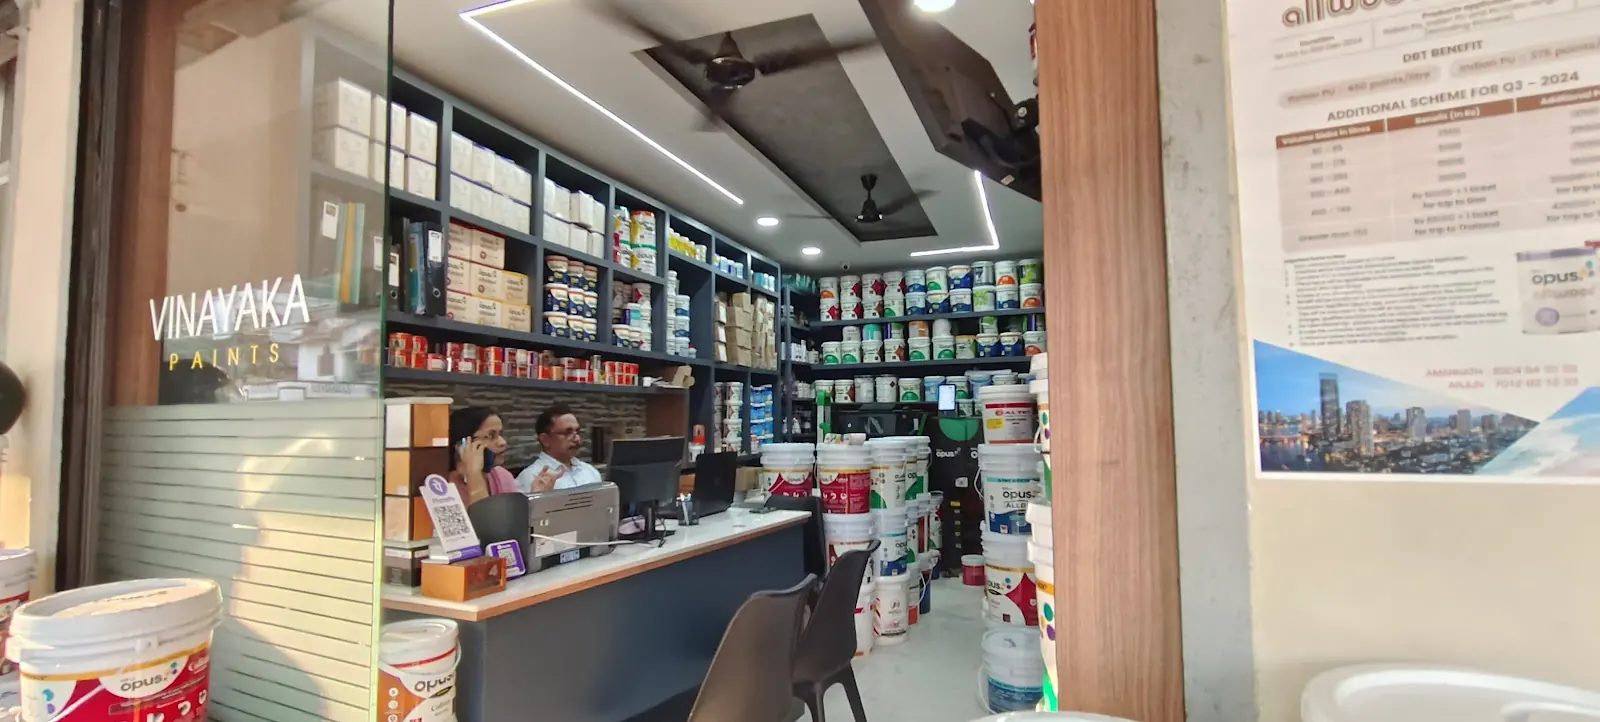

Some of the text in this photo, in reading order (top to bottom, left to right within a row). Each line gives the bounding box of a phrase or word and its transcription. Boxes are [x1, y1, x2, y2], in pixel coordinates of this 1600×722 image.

[1403, 40, 1483, 63] DBT BENEFIT
[1327, 100, 1406, 121] ADDITIONAL
[1410, 88, 1467, 108] SCHEME
[1470, 83, 1499, 98] FOR
[1502, 80, 1524, 93] Q3
[1541, 71, 1580, 88] 2024
[1532, 271, 1579, 287] opus
[149, 274, 310, 341] VINAYAKA
[168, 342, 280, 371] PAINTS
[1003, 490, 1033, 500] opus
[121, 674, 163, 692] opus
